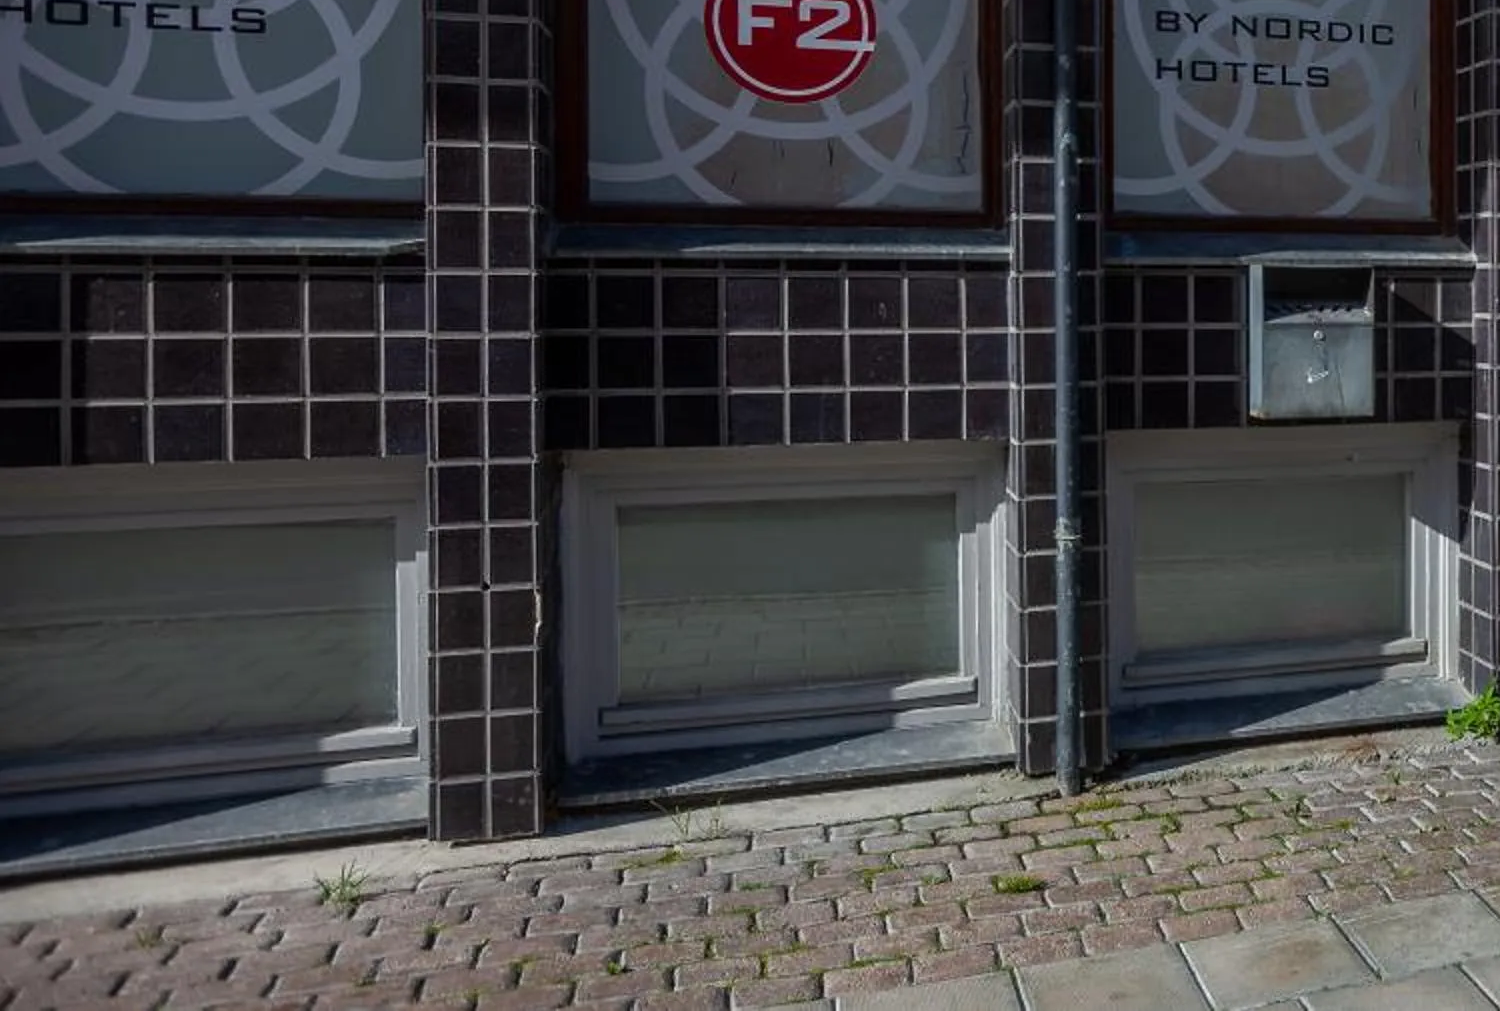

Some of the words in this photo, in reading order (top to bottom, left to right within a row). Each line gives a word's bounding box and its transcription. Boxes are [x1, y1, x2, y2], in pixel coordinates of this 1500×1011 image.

[1155, 10, 1208, 33] BY
[1231, 14, 1394, 45] NORDIC
[1155, 58, 1330, 87] HOTELS
